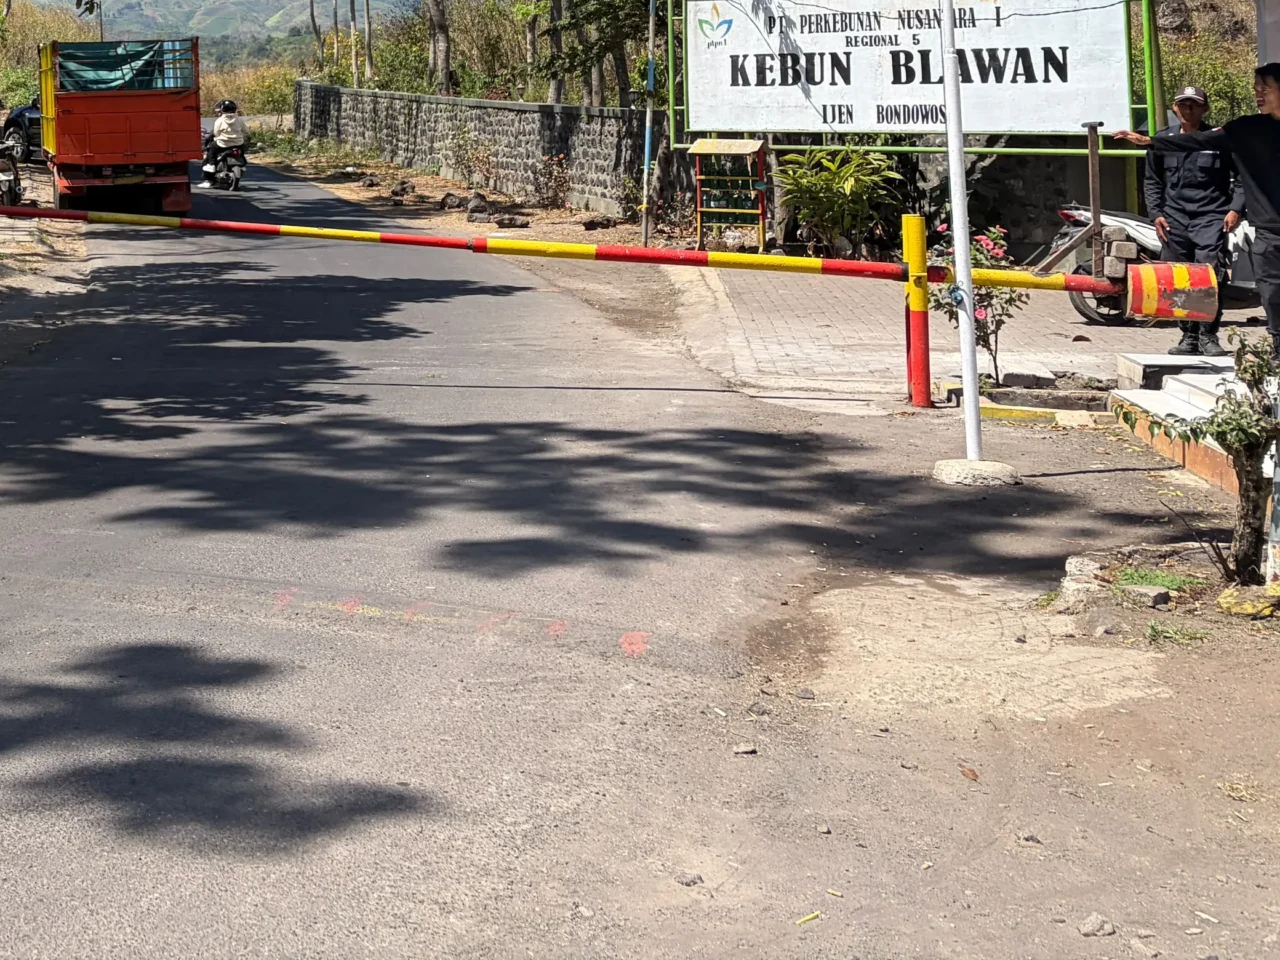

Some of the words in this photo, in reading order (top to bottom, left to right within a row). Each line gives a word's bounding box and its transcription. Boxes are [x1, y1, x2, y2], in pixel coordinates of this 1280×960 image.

[768, 15, 785, 34] PT
[799, 11, 881, 34] PERKEBUNAN
[898, 7, 977, 30] NUSANARA
[845, 35, 901, 47] REGIONAL
[912, 34, 920, 45] 5
[729, 51, 852, 87] KEBUN
[889, 46, 1069, 85] BLAWAN
[821, 104, 854, 124] IJEN
[876, 104, 947, 125] BONDOWOS
